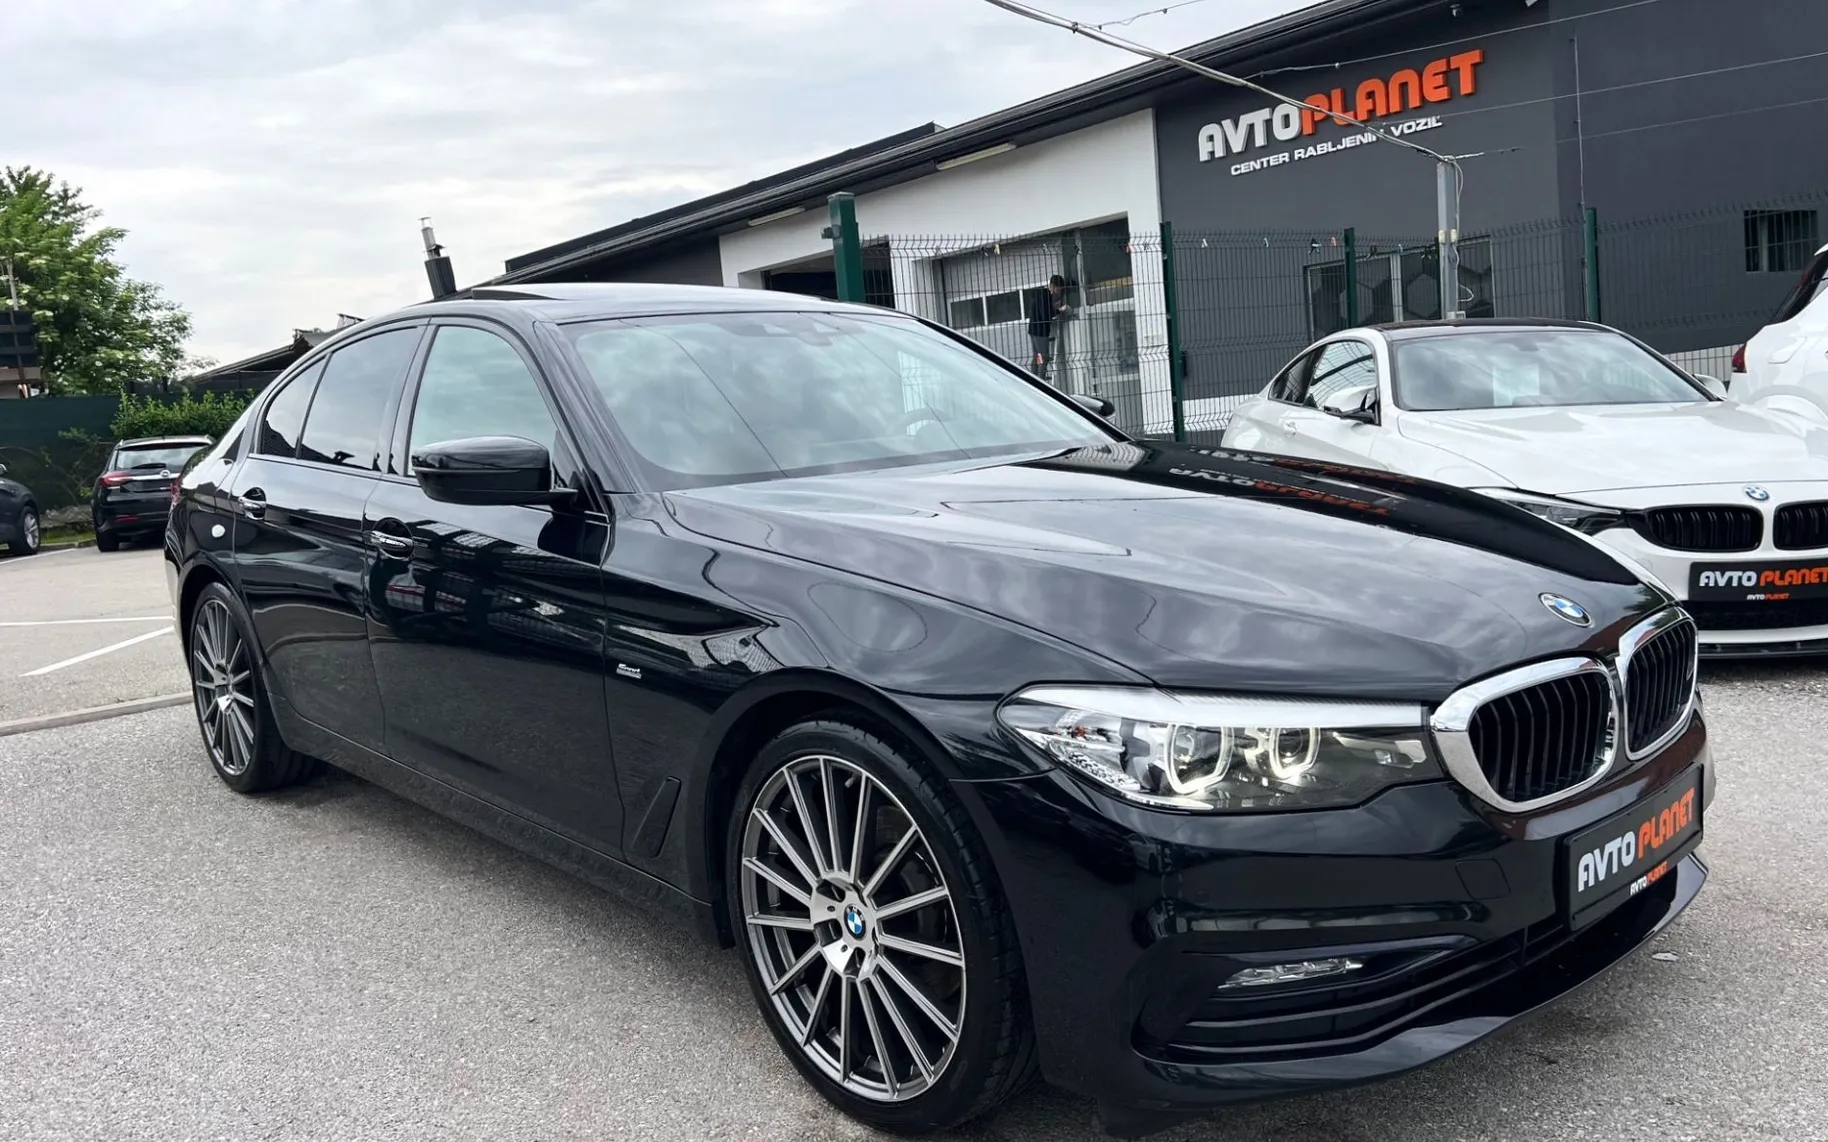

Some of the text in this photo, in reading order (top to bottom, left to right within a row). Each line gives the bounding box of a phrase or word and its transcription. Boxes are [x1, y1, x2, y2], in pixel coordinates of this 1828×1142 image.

[1231, 153, 1290, 176] CENTER
[1390, 115, 1442, 137] VOZIL
[1700, 566, 1828, 587] AVTO PLANET
[1578, 787, 1696, 892] AVTO PLANET
